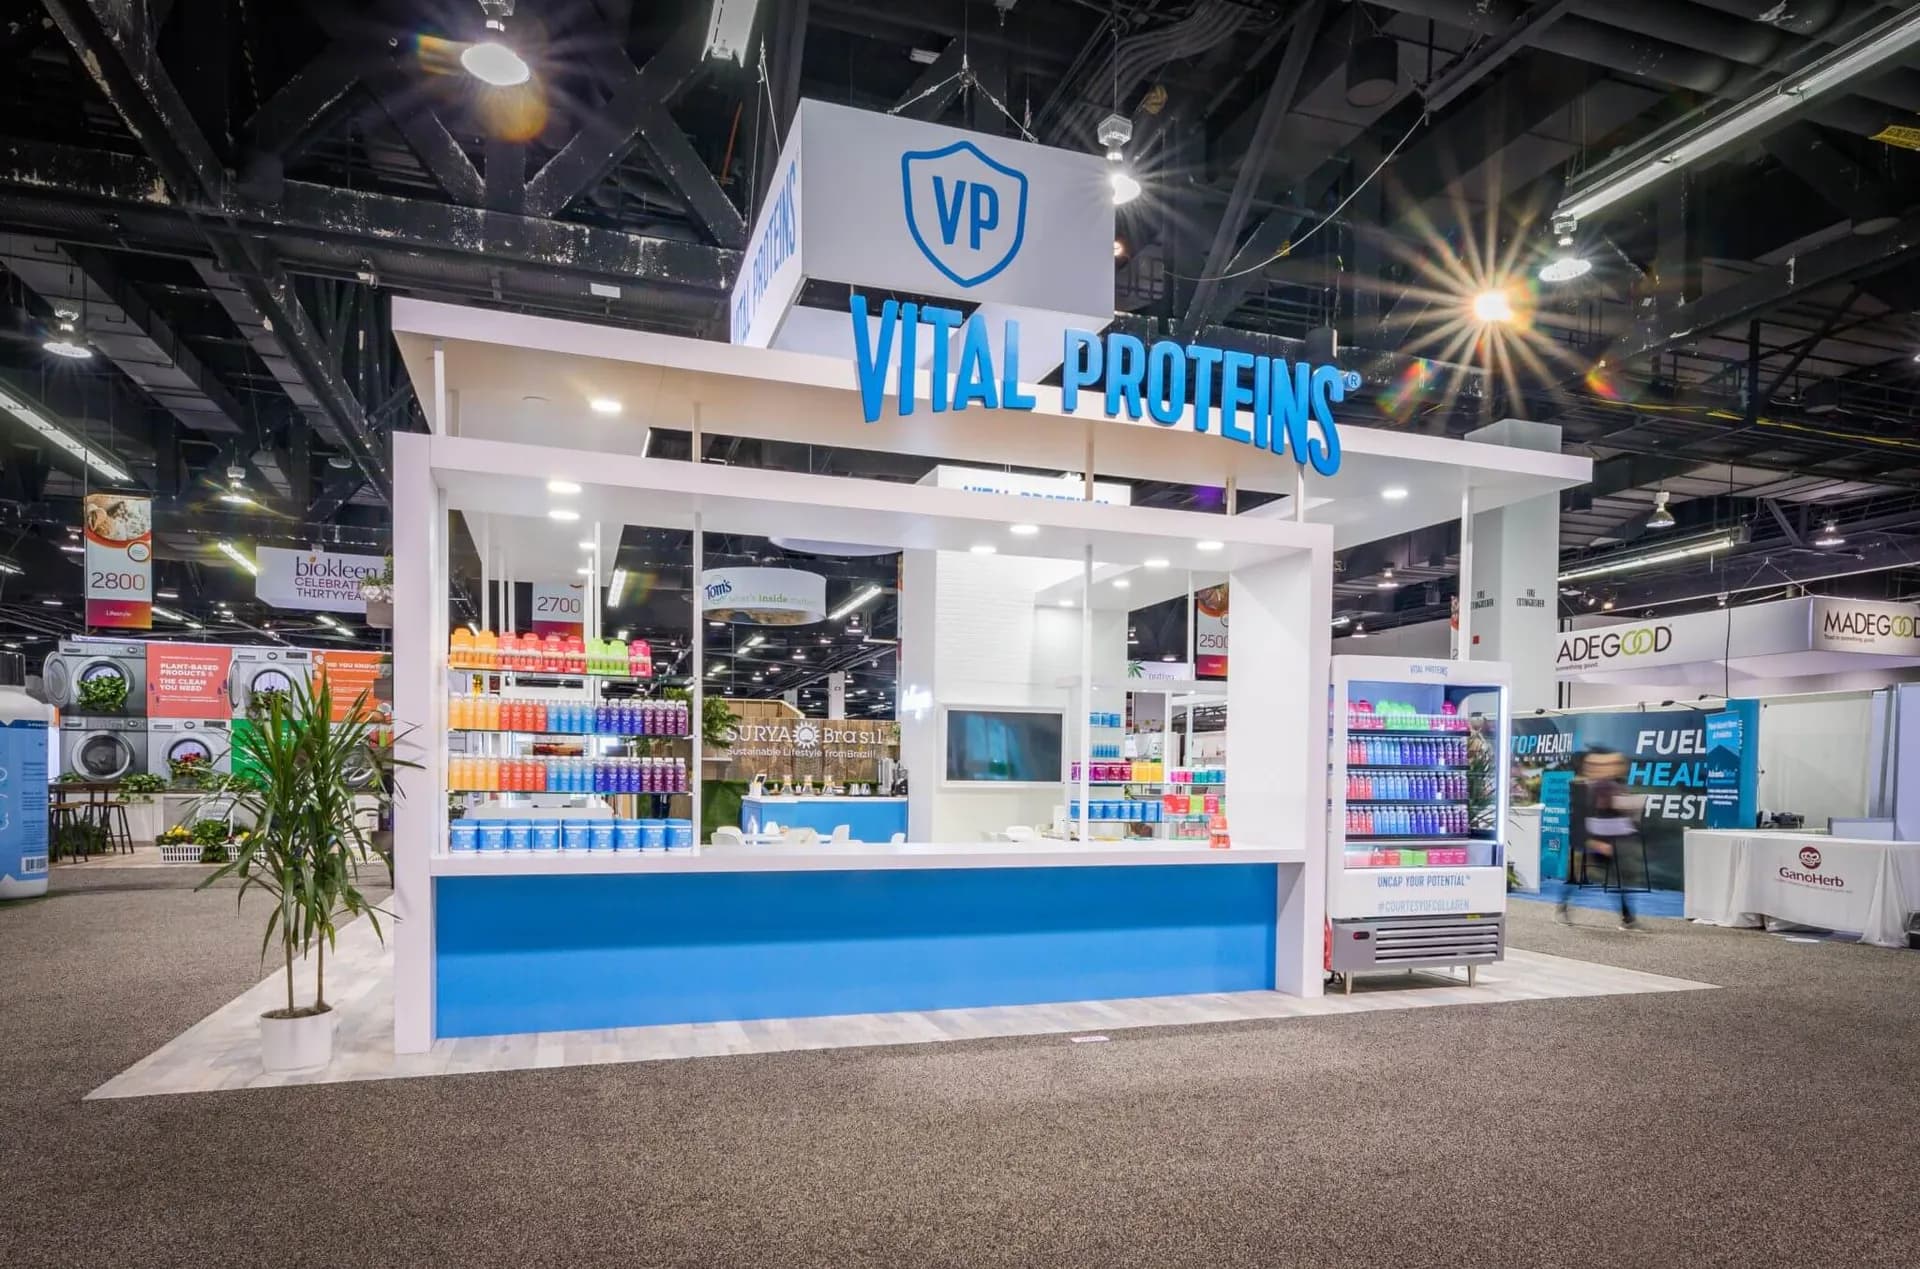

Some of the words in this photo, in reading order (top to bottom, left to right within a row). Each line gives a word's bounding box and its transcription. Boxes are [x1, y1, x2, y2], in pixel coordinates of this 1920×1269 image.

[932, 175, 999, 250] VP
[753, 160, 796, 317] PROTEINS
[849, 294, 1036, 423] VITAL
[295, 556, 378, 580] biokleen
[91, 571, 146, 591] 2800
[705, 579, 732, 600] Tom's
[537, 596, 581, 614] 2700
[1556, 626, 1673, 663] ADEGOOD
[160, 663, 219, 671] PLANT-BASED
[160, 678, 177, 686] THE
[160, 684, 177, 692] YOU
[727, 725, 793, 742] SURYA
[823, 728, 883, 744] Brasil
[783, 749, 823, 759] Lifestyle
[1627, 762, 1707, 787] HEAL
[1377, 876, 1403, 888] UNCAP
[1405, 876, 1425, 887] YOUR
[1779, 867, 1844, 887] GanoHerb
